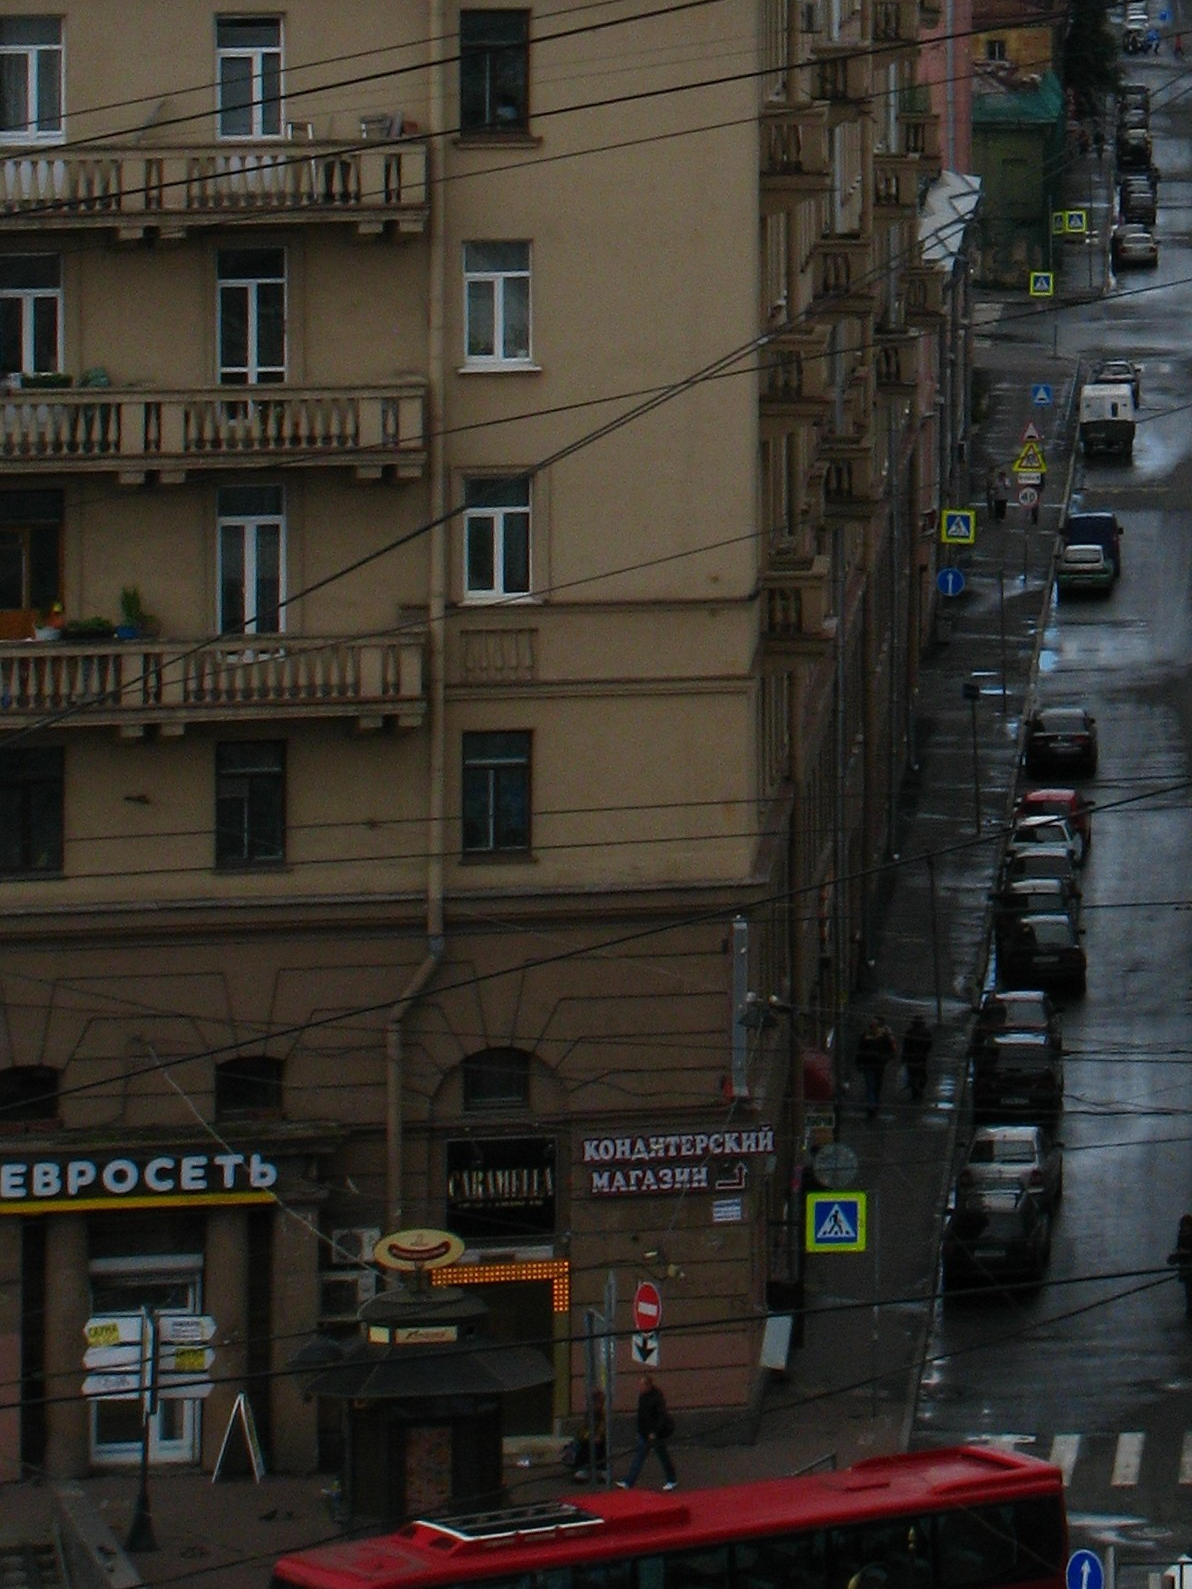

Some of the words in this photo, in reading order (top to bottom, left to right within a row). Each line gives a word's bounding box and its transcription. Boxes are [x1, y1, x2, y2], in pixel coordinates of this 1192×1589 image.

[584, 1125, 775, 1161] КОНДИТЕРСКИЙ
[0, 1153, 279, 1198] ЕВРОСЕТЬ
[591, 1167, 709, 1194] МАГАЗИН
